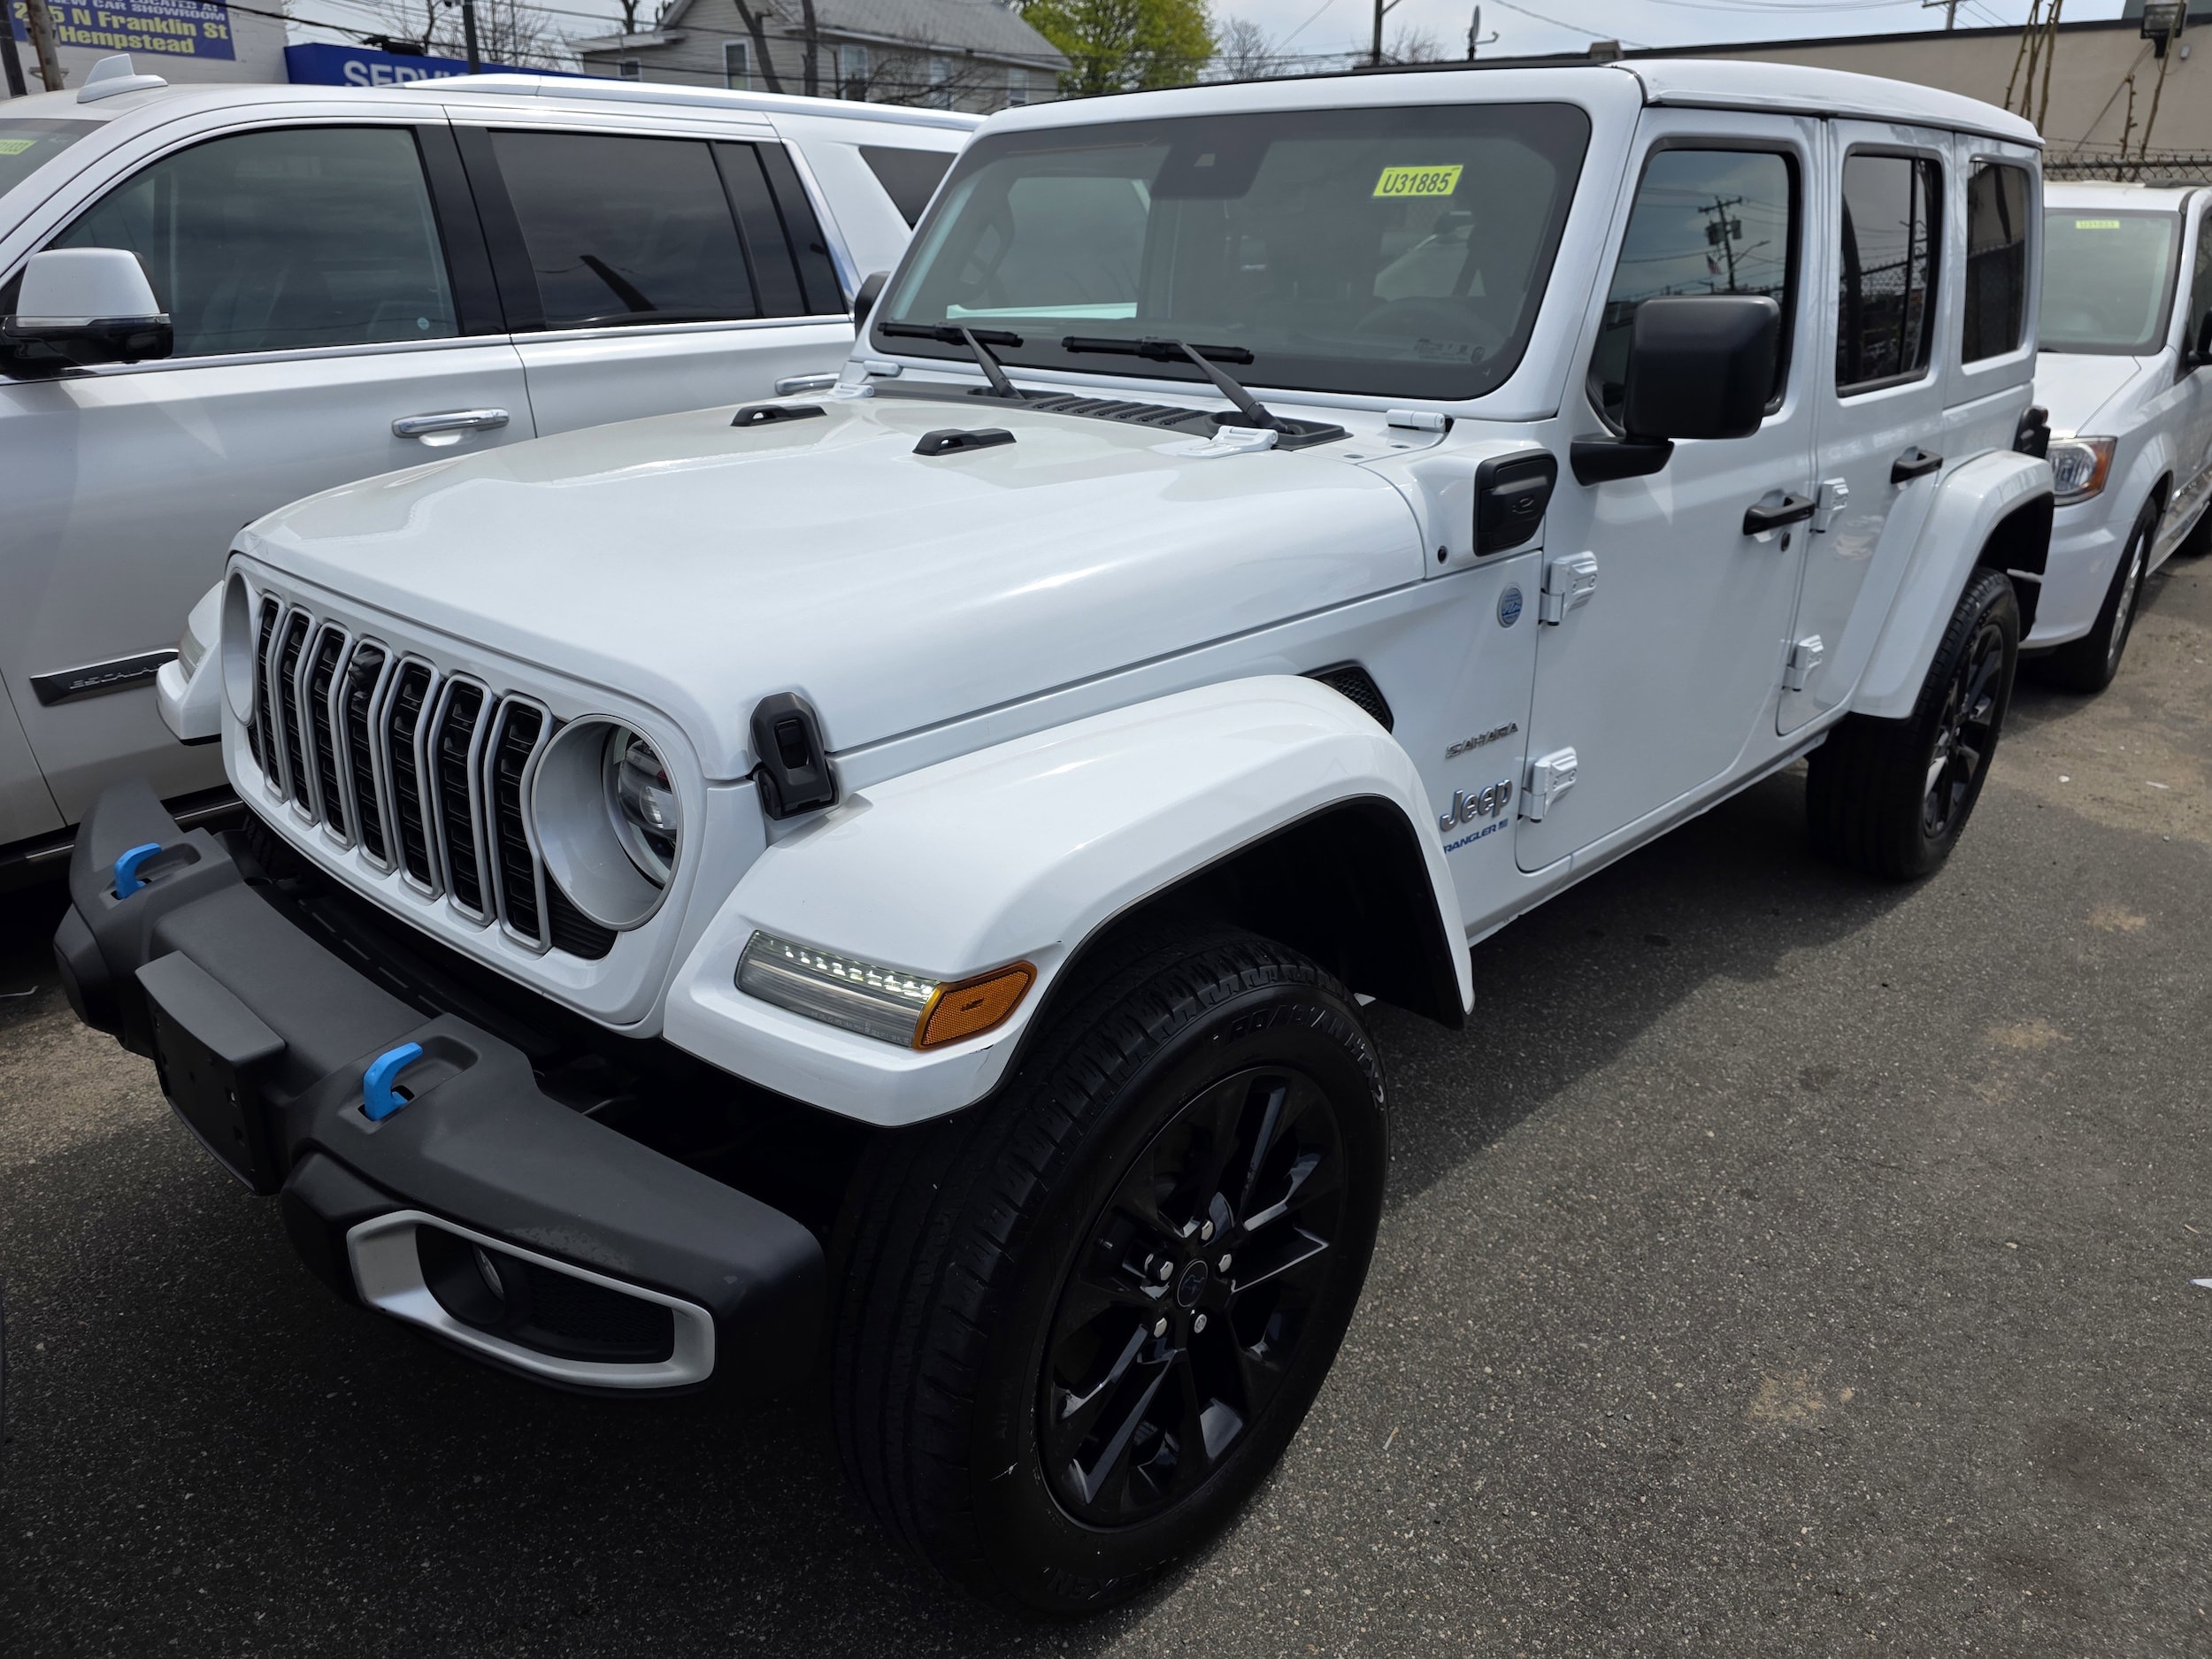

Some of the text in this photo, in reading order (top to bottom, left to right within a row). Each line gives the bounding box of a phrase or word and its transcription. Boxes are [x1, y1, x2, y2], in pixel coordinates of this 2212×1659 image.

[73, 10, 93, 27] N
[97, 12, 197, 37] Franklin
[203, 21, 230, 40] St
[93, 0, 127, 12] CAR
[131, 4, 226, 22] SHOWROOM
[59, 25, 196, 54] Hempstead
[1383, 172, 1453, 194] U31885
[1446, 722, 1518, 758] SAHARA
[1440, 779, 1513, 832] Jeep
[1443, 824, 1497, 854] RANGLER
